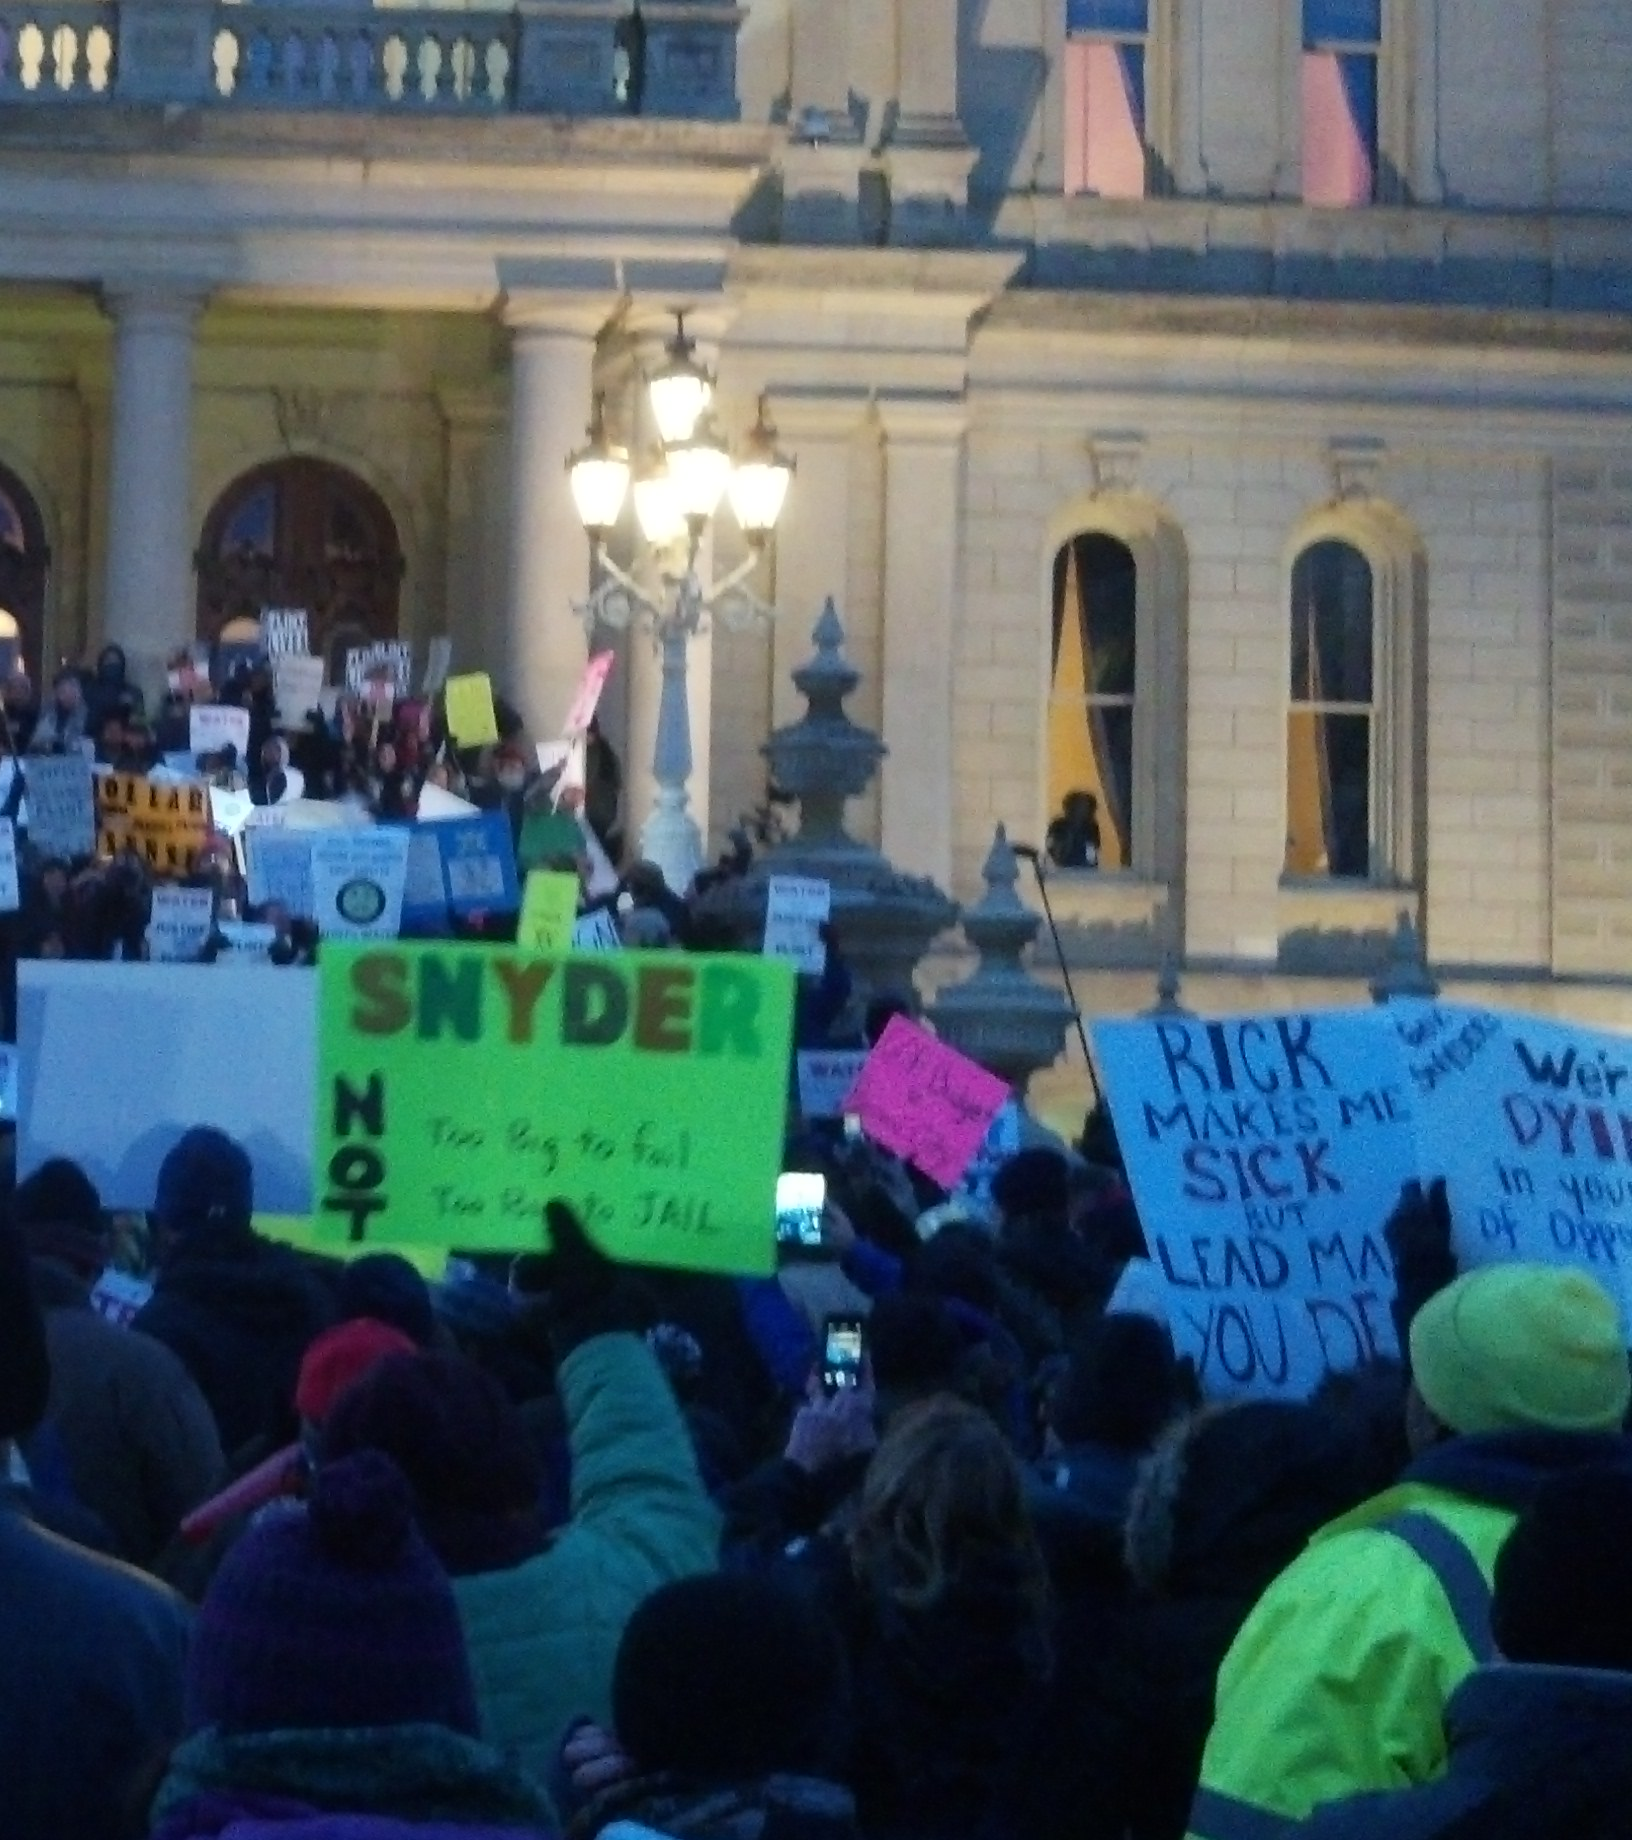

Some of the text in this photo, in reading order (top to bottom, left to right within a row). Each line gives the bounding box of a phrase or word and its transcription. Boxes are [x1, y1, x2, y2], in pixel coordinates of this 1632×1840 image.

[350, 951, 763, 1058] SNYDER
[1156, 1016, 1332, 1094] RICK
[1143, 1087, 1412, 1140] MAKES ME
[1501, 1092, 1632, 1162] DYI
[324, 1071, 388, 1241] NOT
[1182, 1139, 1343, 1202] SICK
[1245, 1200, 1307, 1231] BUT
[1558, 1172, 1632, 1216] you
[1154, 1230, 1396, 1291] LEAD MA
[1181, 1303, 1289, 1384] YOU
